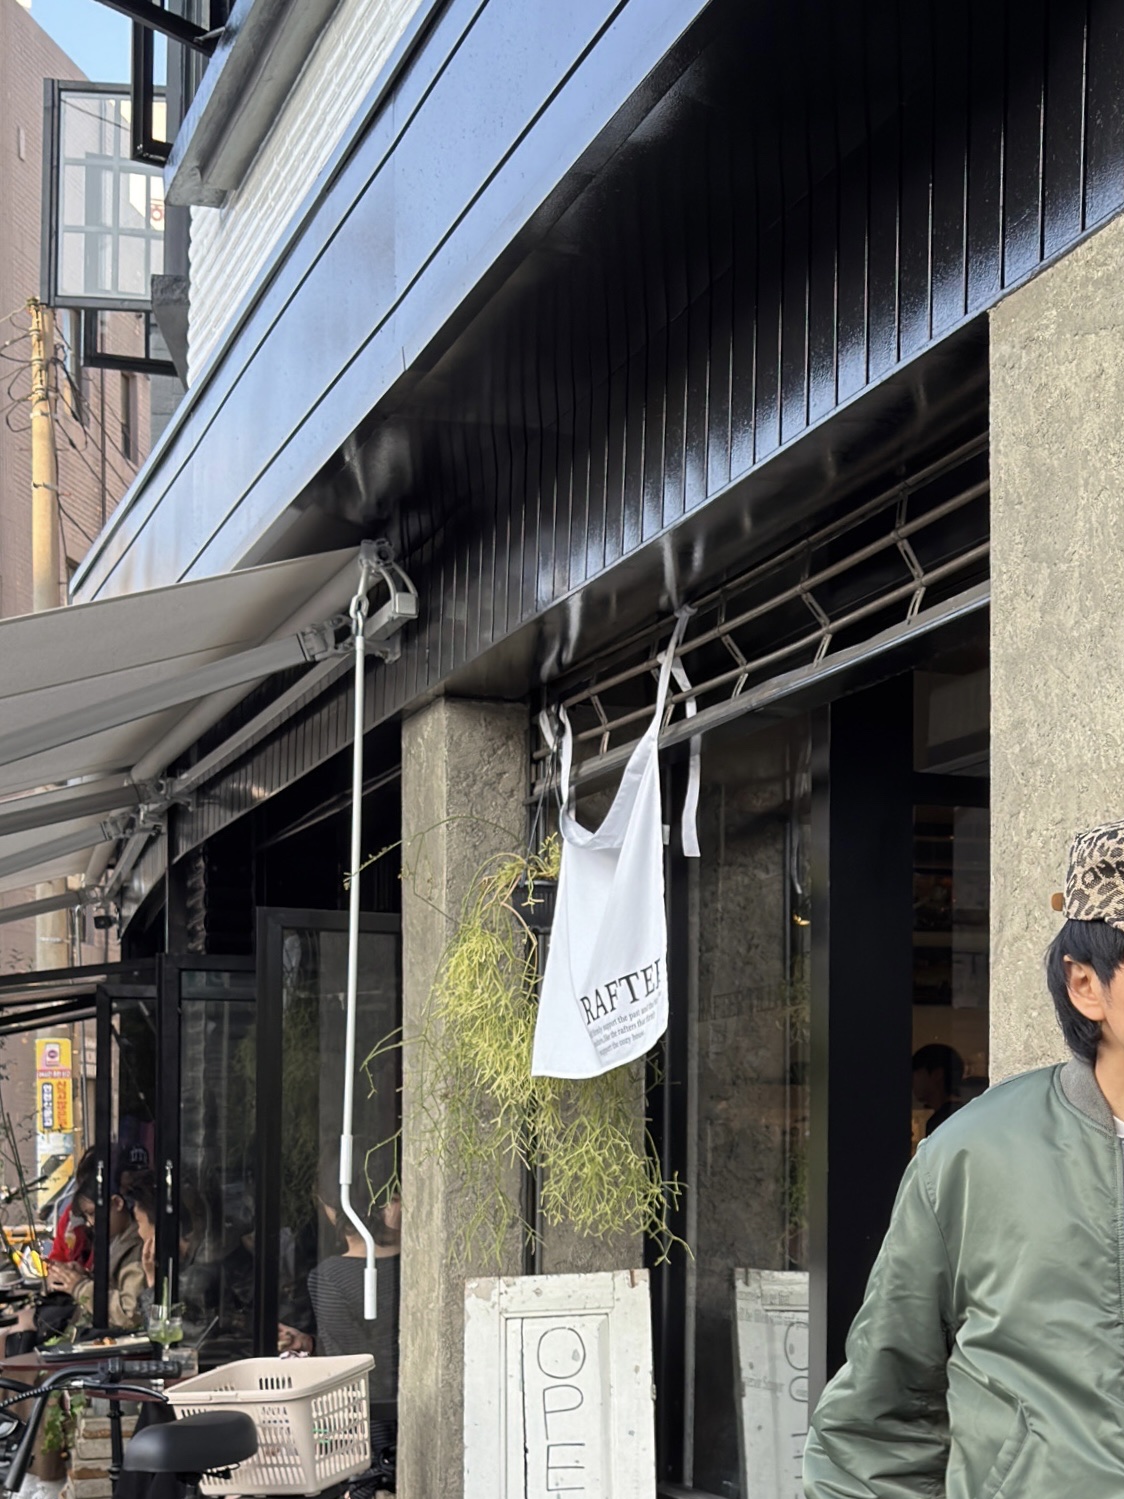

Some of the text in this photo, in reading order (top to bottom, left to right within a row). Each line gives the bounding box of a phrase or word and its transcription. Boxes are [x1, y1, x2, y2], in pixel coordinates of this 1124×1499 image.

[617, 1013, 628, 1024] the
[629, 1009, 640, 1021] past
[617, 1022, 637, 1036] rafters
